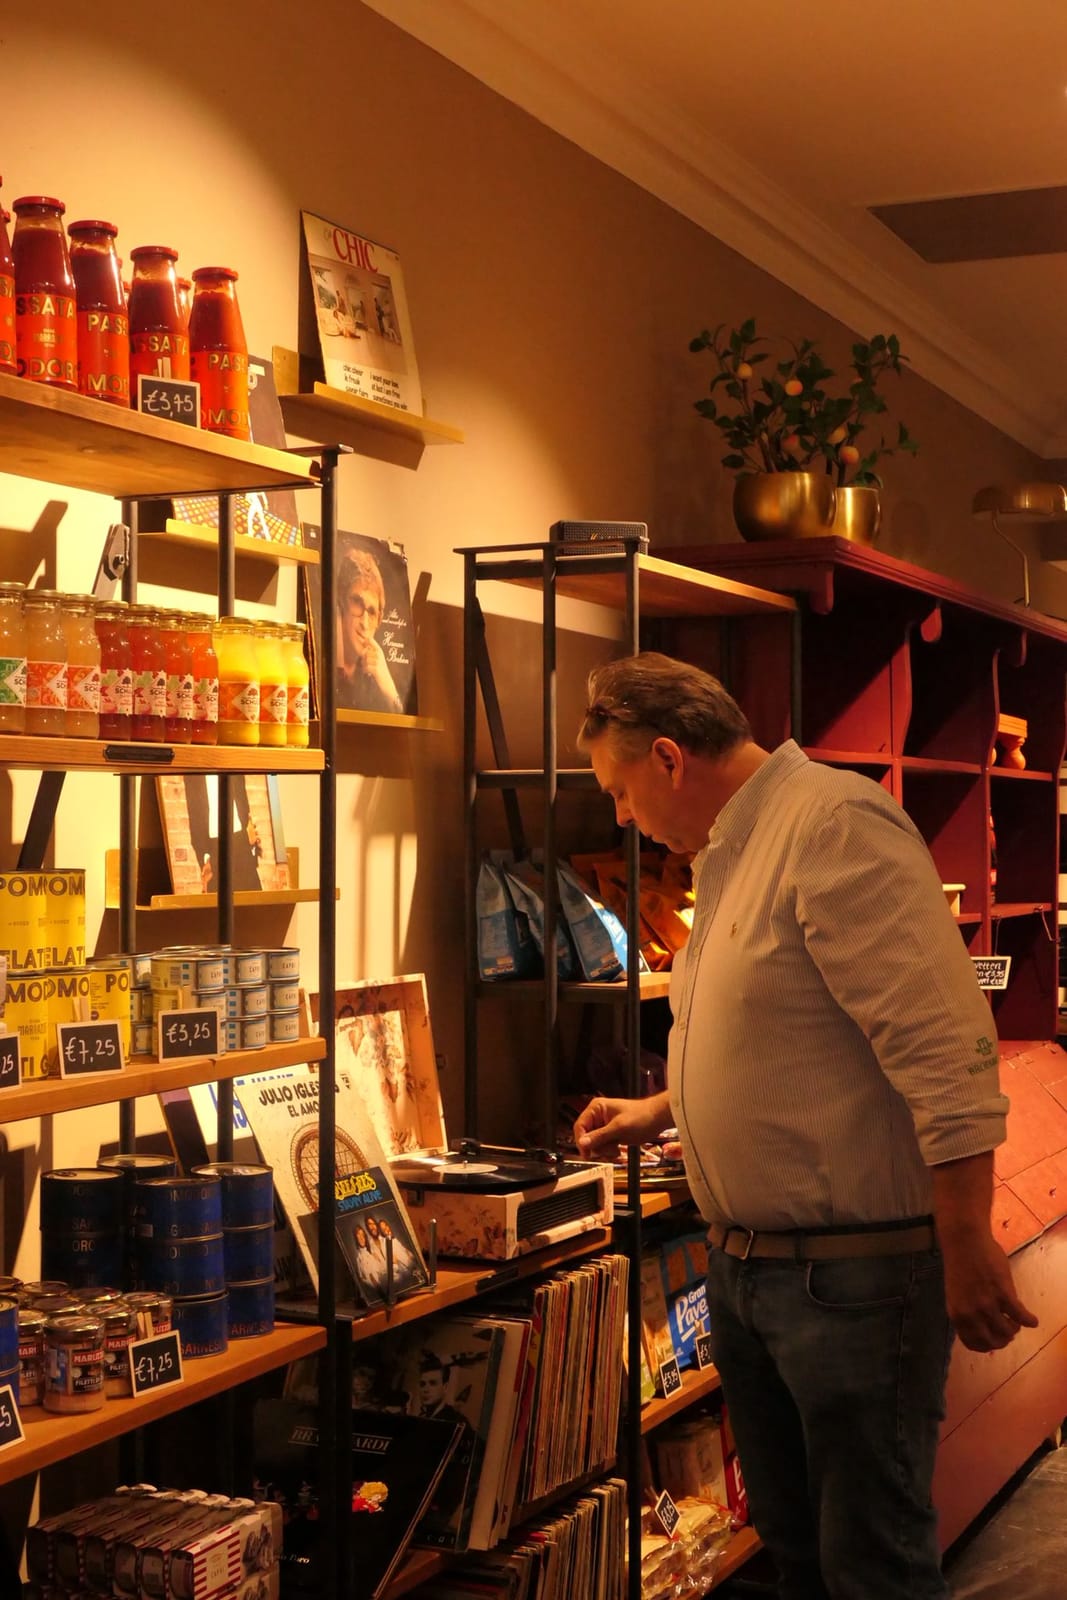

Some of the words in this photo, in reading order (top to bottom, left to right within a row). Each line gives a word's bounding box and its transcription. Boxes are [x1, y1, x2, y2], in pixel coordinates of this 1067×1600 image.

[333, 228, 378, 273] CHIC
[166, 1022, 211, 1048] €3,25
[64, 1036, 116, 1064] €7,25
[258, 1085, 293, 1106] JULIO
[287, 1105, 299, 1118] EL
[675, 1295, 709, 1335] Pave
[135, 1352, 173, 1383] €7,25
